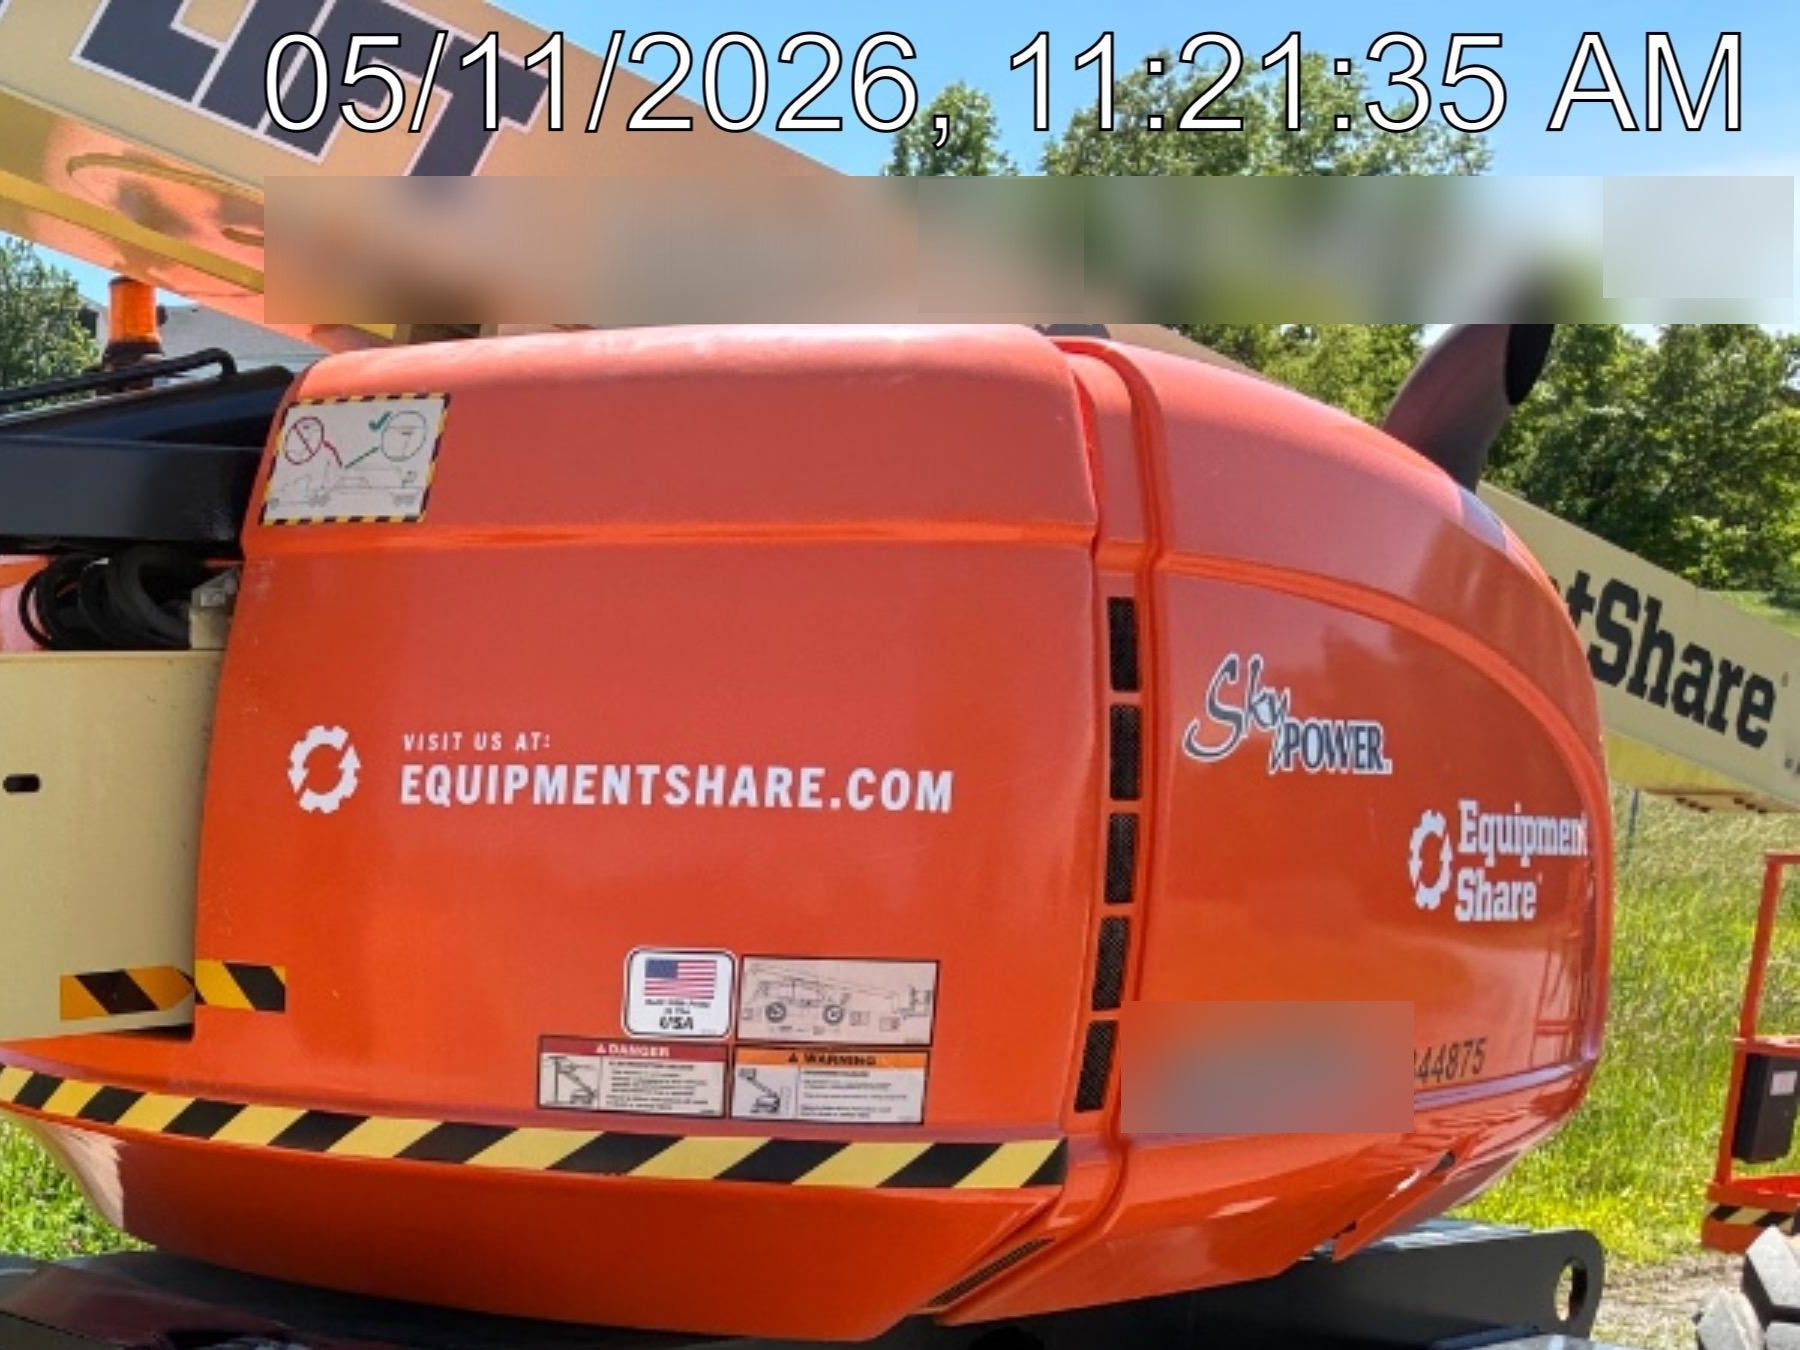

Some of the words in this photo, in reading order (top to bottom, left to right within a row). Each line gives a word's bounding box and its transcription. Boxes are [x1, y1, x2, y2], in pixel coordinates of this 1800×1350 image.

[1552, 570, 1776, 750] tShare
[1182, 653, 1291, 775] Sky
[403, 732, 462, 751] VISIT
[474, 732, 502, 751] US
[515, 732, 550, 752] AT:
[400, 763, 953, 814] EQUIPMENTSHARE.COM
[1455, 867, 1537, 922] Share
[659, 1016, 694, 1030] USA
[608, 1043, 670, 1058] DANGER
[803, 1052, 877, 1066] WARNING
[1413, 1036, 1488, 1084] 44875
